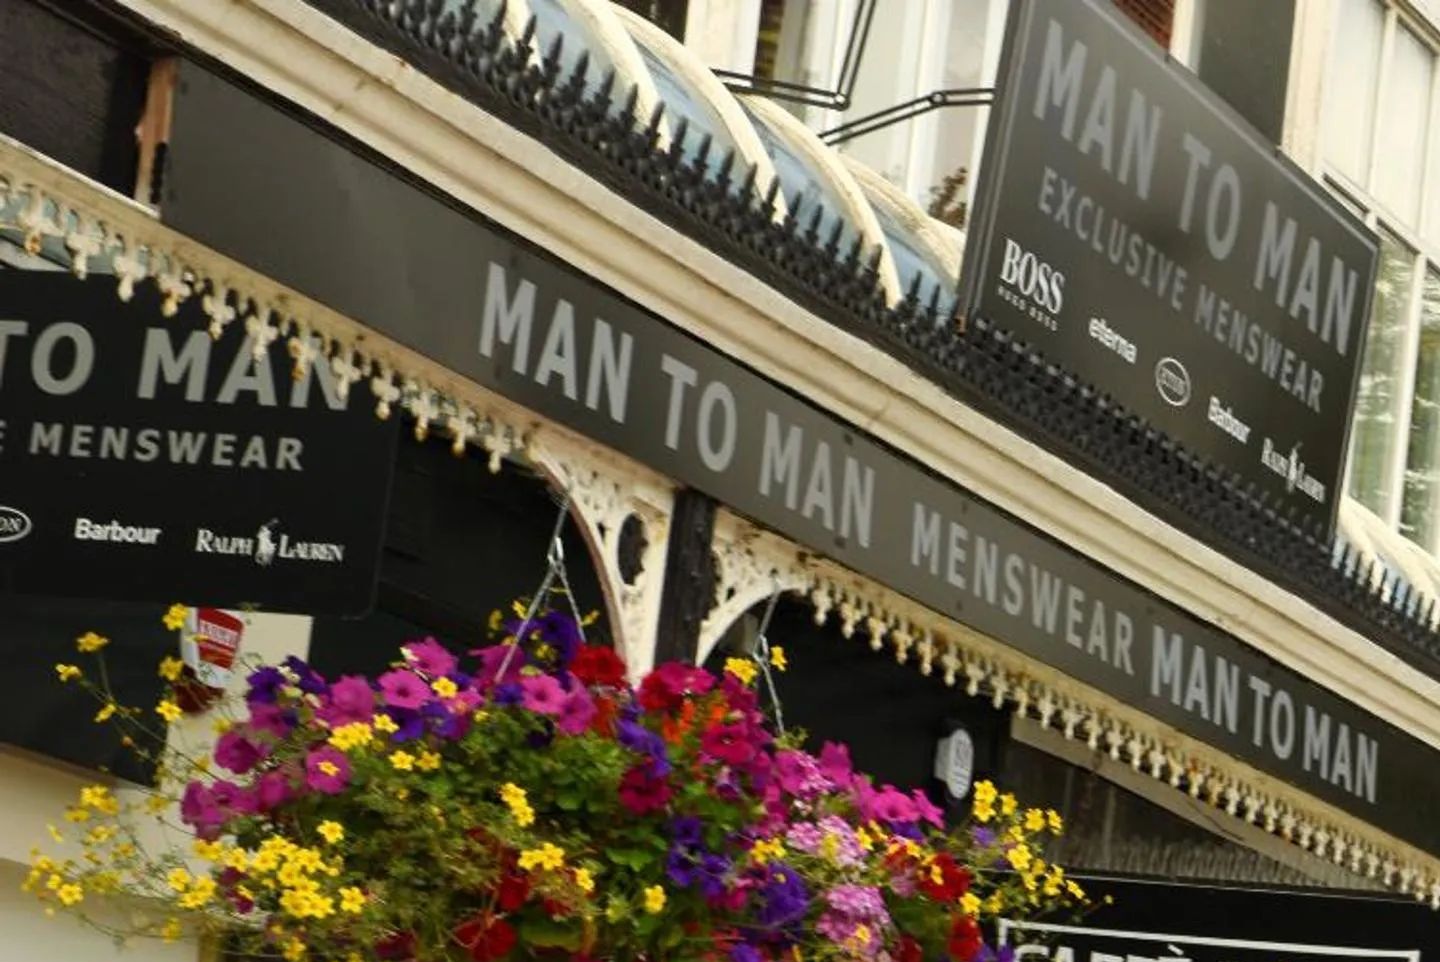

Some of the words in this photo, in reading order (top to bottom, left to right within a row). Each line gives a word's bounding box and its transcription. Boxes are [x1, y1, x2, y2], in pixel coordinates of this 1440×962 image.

[1033, 17, 1164, 200] MAN
[1178, 132, 1242, 261] TO
[1254, 200, 1359, 357] MAN
[1000, 238, 1066, 314] BOSS
[1039, 167, 1188, 311] EXCLUSIVE
[1195, 284, 1324, 413] MENSWEAR
[137, 327, 348, 411] MAN
[29, 421, 304, 471] MENSWEAR
[75, 518, 162, 545] Barbour
[478, 261, 634, 424] MAN
[661, 354, 738, 473] TO
[758, 409, 875, 548] MAN
[911, 503, 1135, 676] MENSWEAR
[1151, 624, 1241, 734] MAN
[1249, 675, 1296, 760] TO
[1303, 706, 1379, 803] MAN
